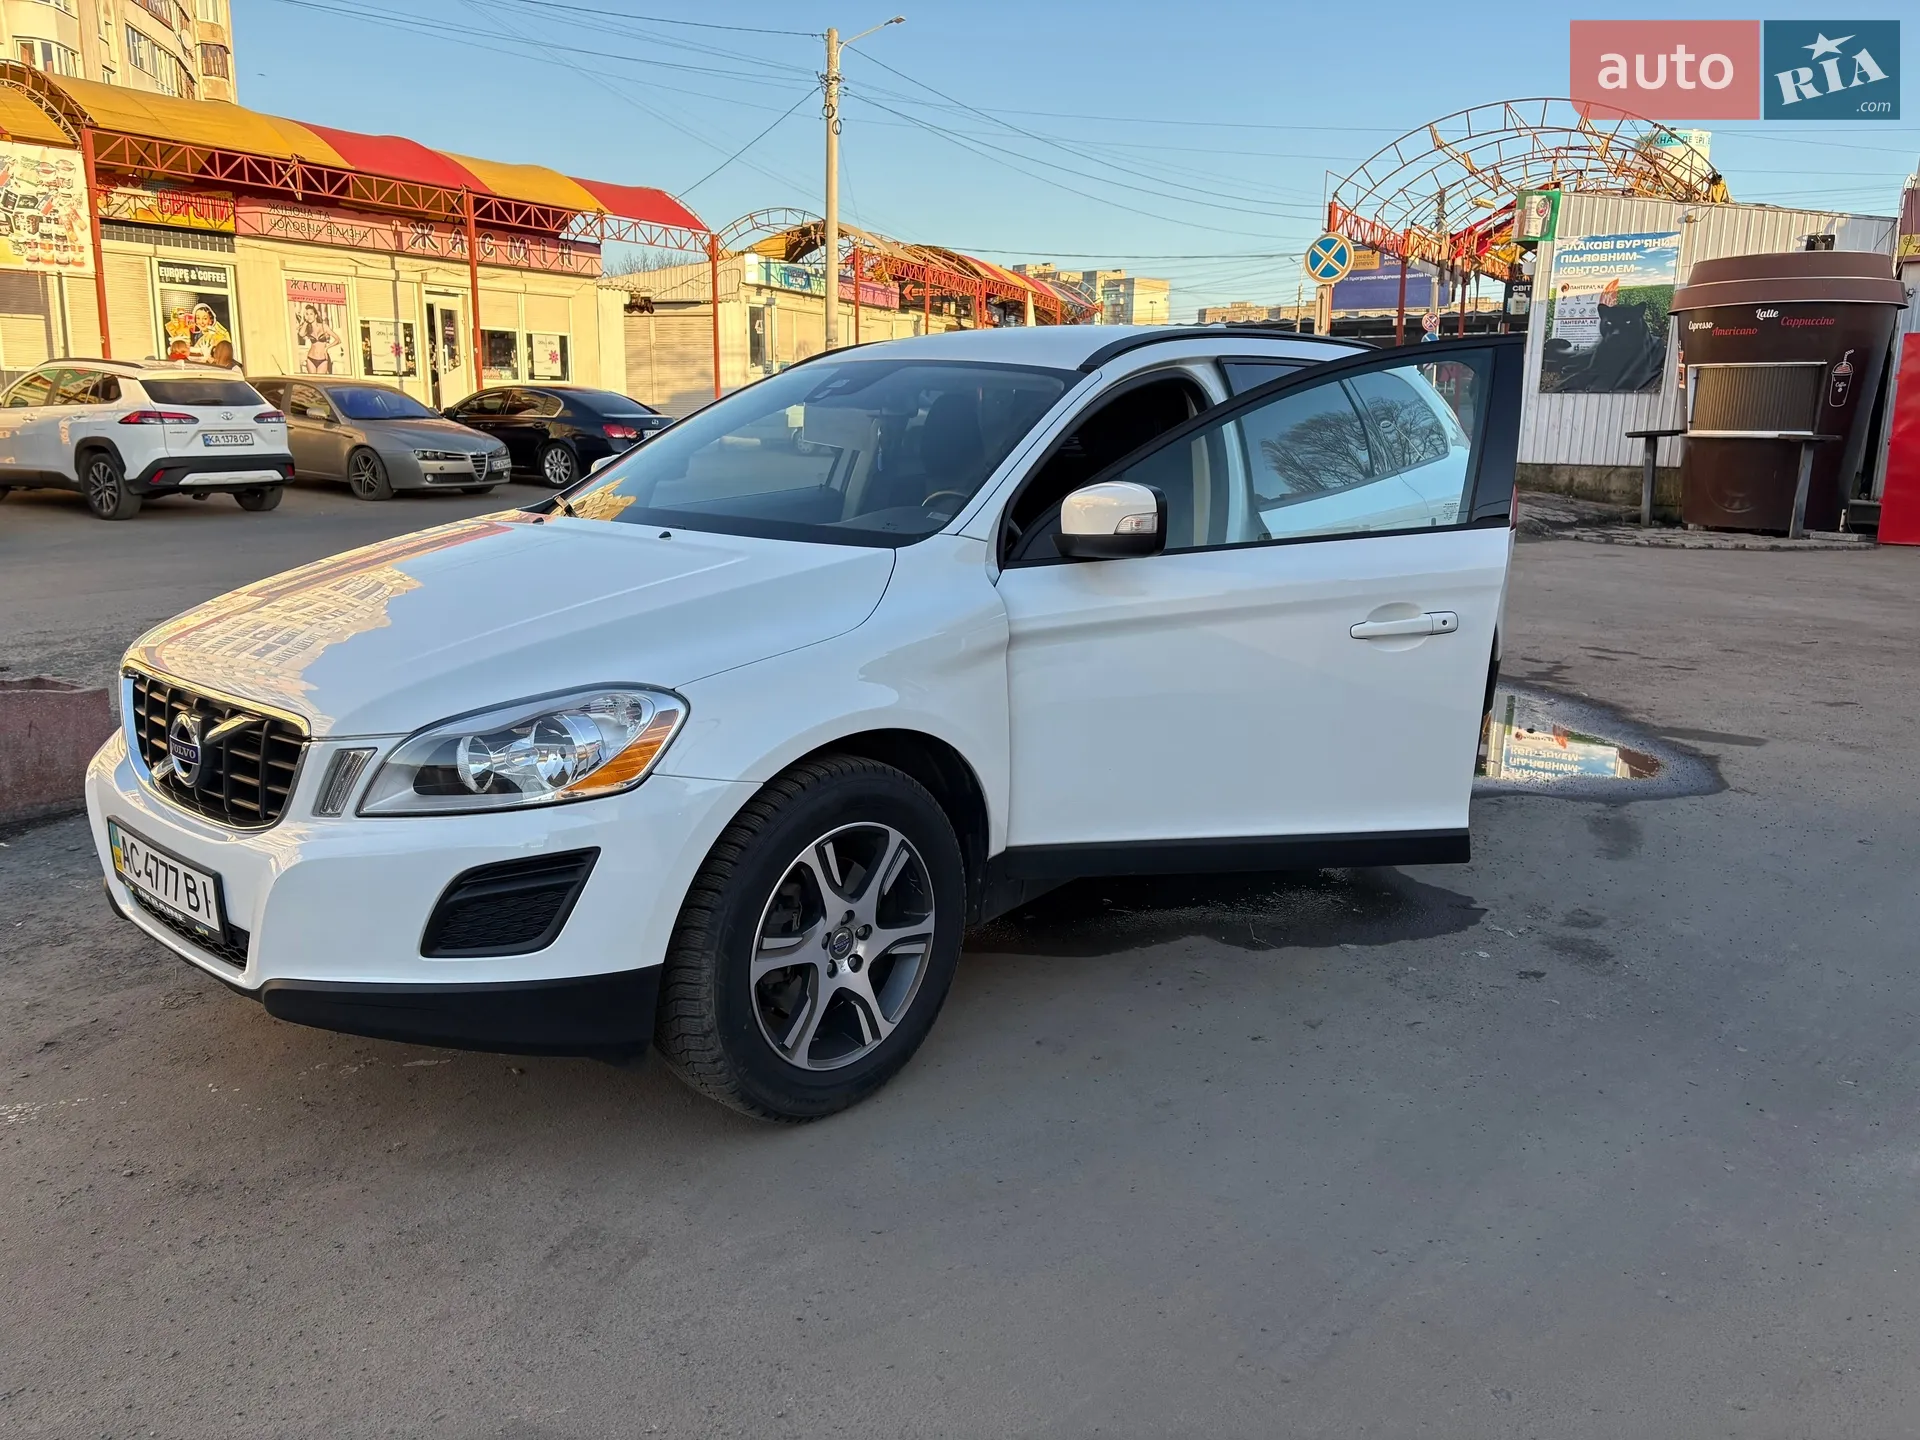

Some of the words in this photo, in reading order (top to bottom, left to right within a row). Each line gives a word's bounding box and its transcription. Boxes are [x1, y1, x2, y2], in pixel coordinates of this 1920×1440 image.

[268, 202, 314, 218] ЖІНОЧА
[316, 209, 332, 221] ТА
[270, 218, 322, 235] ЧОЛОВІЧА
[326, 225, 369, 241] БІЛИЗНА
[408, 222, 573, 269] ЖАСМІН
[1562, 241, 1614, 251] ЗЛАКОВІ
[1616, 239, 1671, 249] БУР'ЯНИ
[1561, 254, 1581, 263] ПІД
[1583, 252, 1637, 262] ПОВНИМ
[159, 267, 189, 281] EUROPE
[190, 269, 198, 279] &
[197, 270, 226, 282] COFFEE
[1559, 264, 1635, 275] КОНТРОЛЕМ
[290, 280, 341, 293] ЖАСМІН
[1688, 320, 1714, 332] Espresso
[1780, 316, 1835, 328] Cappuccino
[1711, 326, 1758, 336] Americano
[221, 434, 239, 443] 1378
[239, 434, 250, 442] OP
[172, 742, 196, 758] VOLVO
[122, 836, 141, 878] AC
[144, 851, 179, 902] 4777
[183, 871, 211, 920] BI
